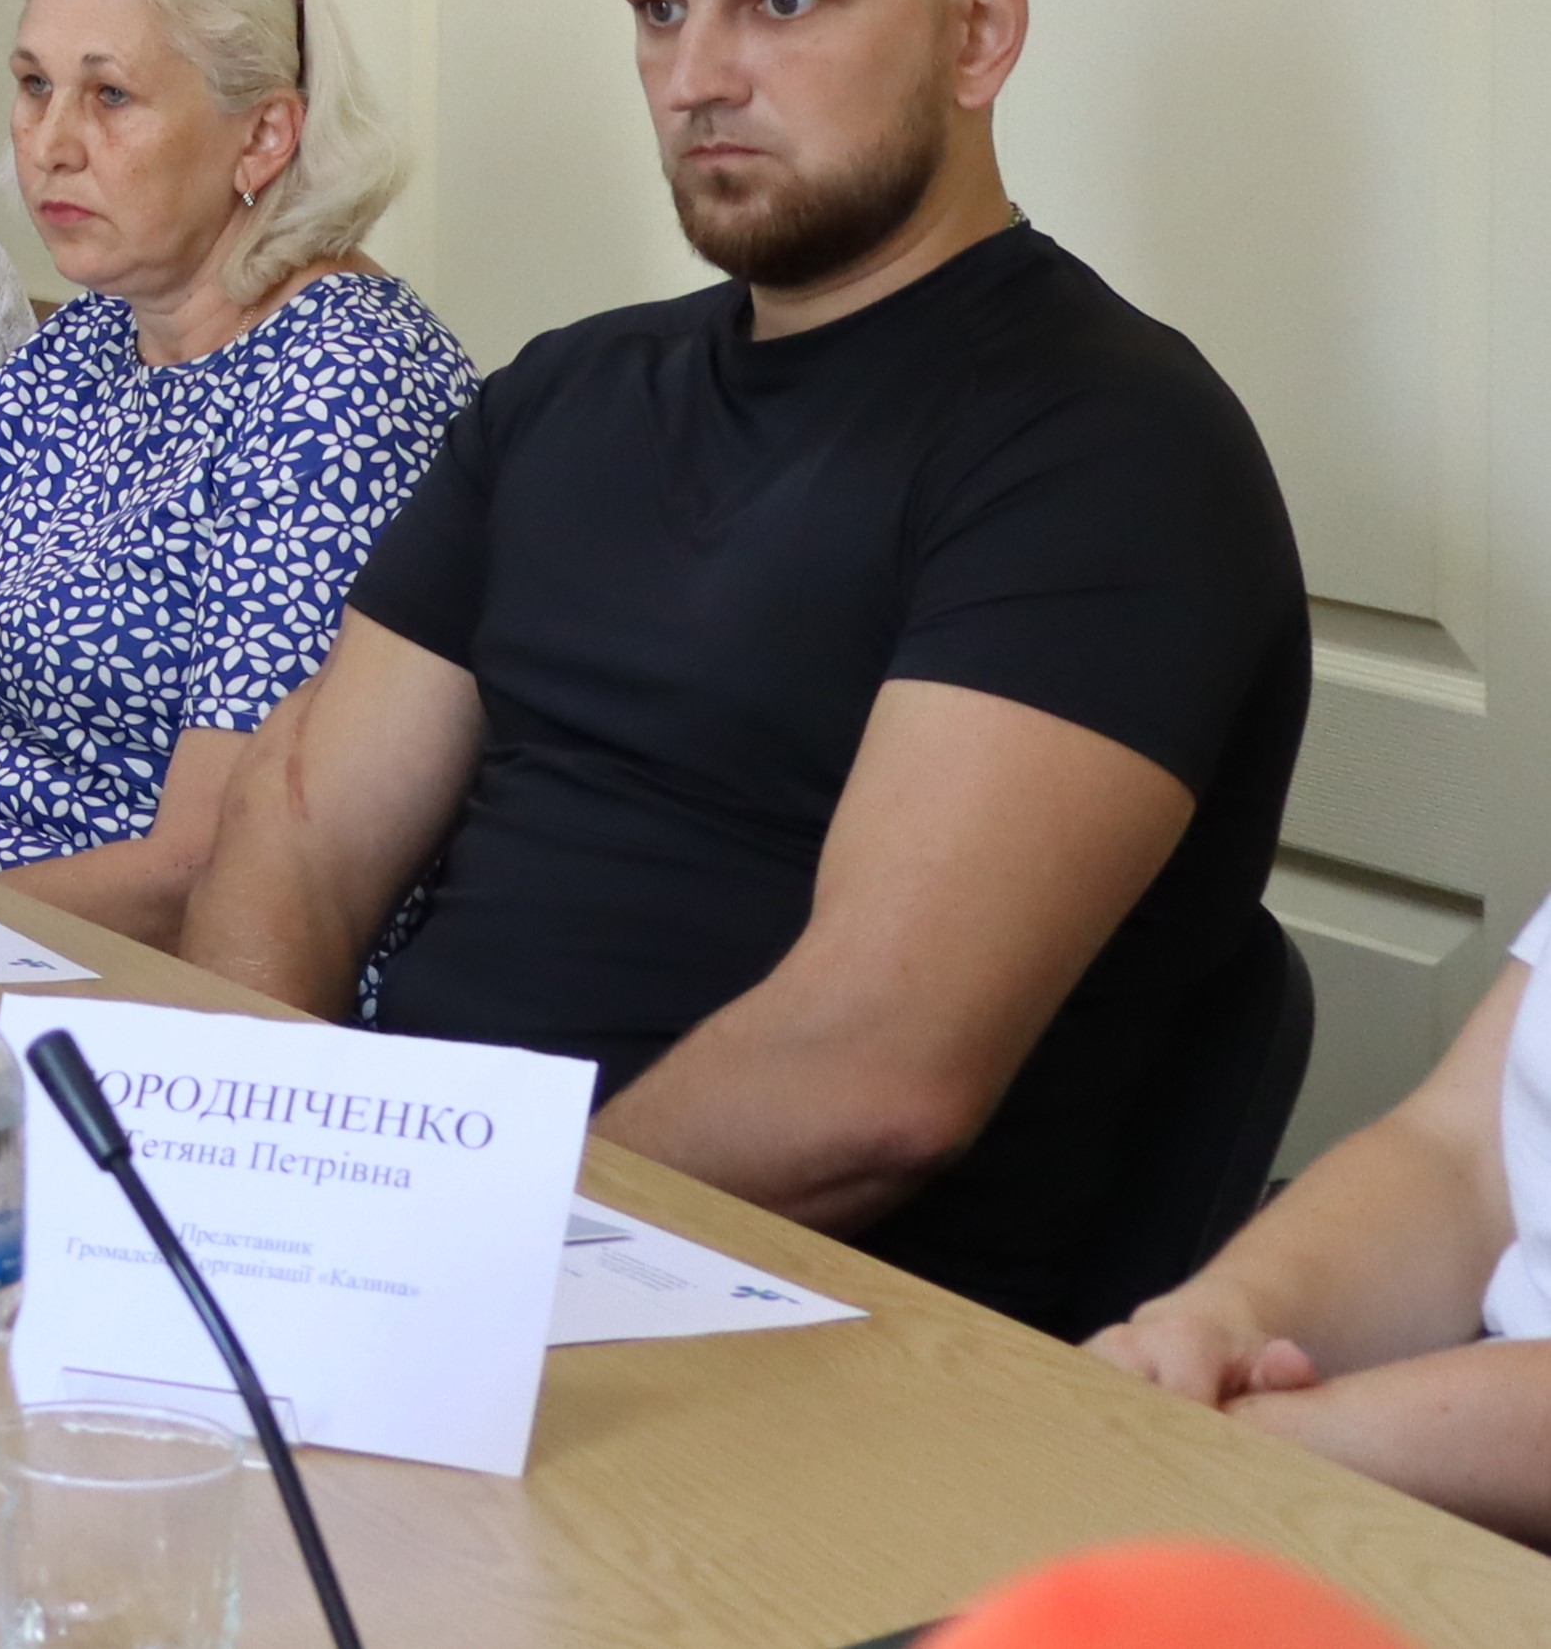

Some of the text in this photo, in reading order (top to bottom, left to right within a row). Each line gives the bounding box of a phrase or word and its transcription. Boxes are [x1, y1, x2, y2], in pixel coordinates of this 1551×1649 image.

[98, 1069, 495, 1151] ОРОДНІЧЕНКО
[248, 1141, 412, 1188] Петрівна
[179, 1221, 314, 1256] Представник
[198, 1254, 313, 1285] організації
[318, 1267, 421, 1299] «Калина»
